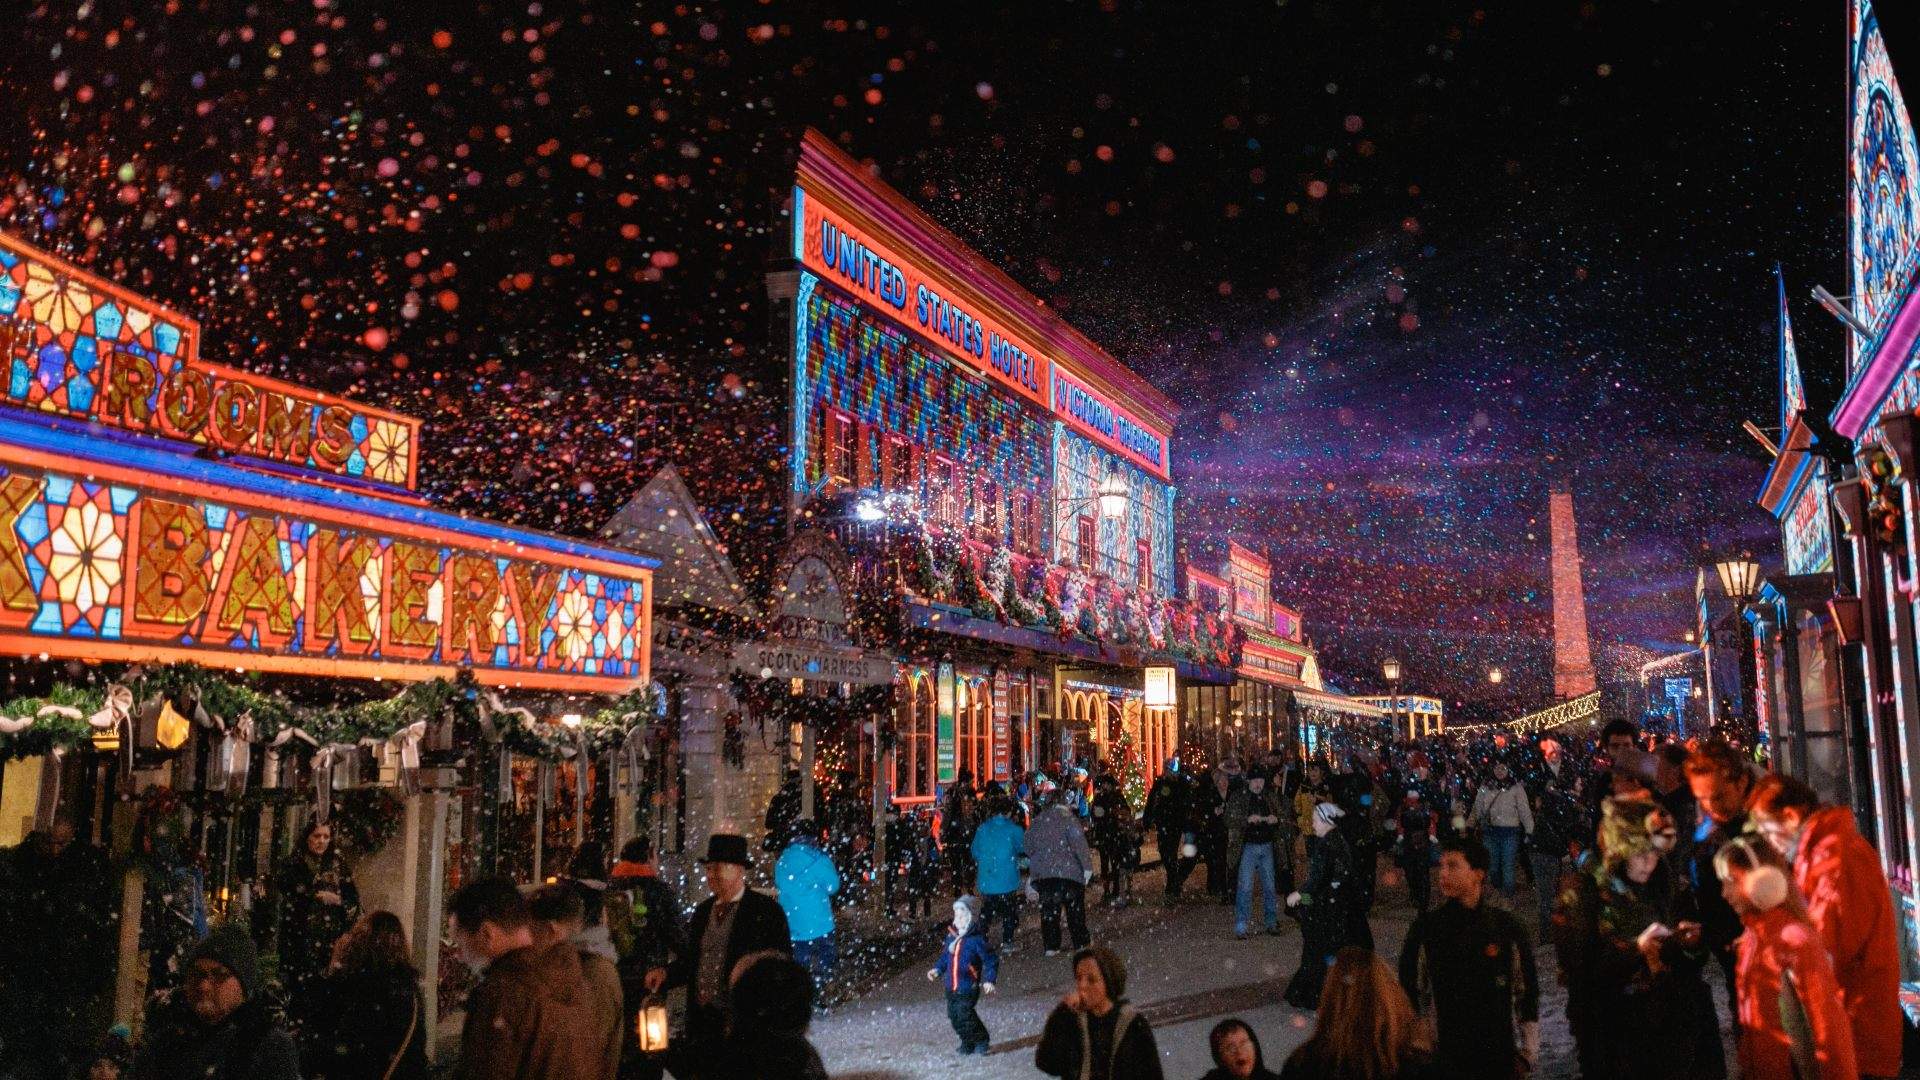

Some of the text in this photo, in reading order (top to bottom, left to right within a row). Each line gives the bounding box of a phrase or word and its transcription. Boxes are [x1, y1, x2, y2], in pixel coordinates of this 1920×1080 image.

[821, 218, 1039, 394] UNITED STATES HOTEL
[104, 350, 353, 464] ROOMS
[1058, 376, 1161, 468] VICTORIA THEATRE
[128, 496, 563, 660] BAKERY
